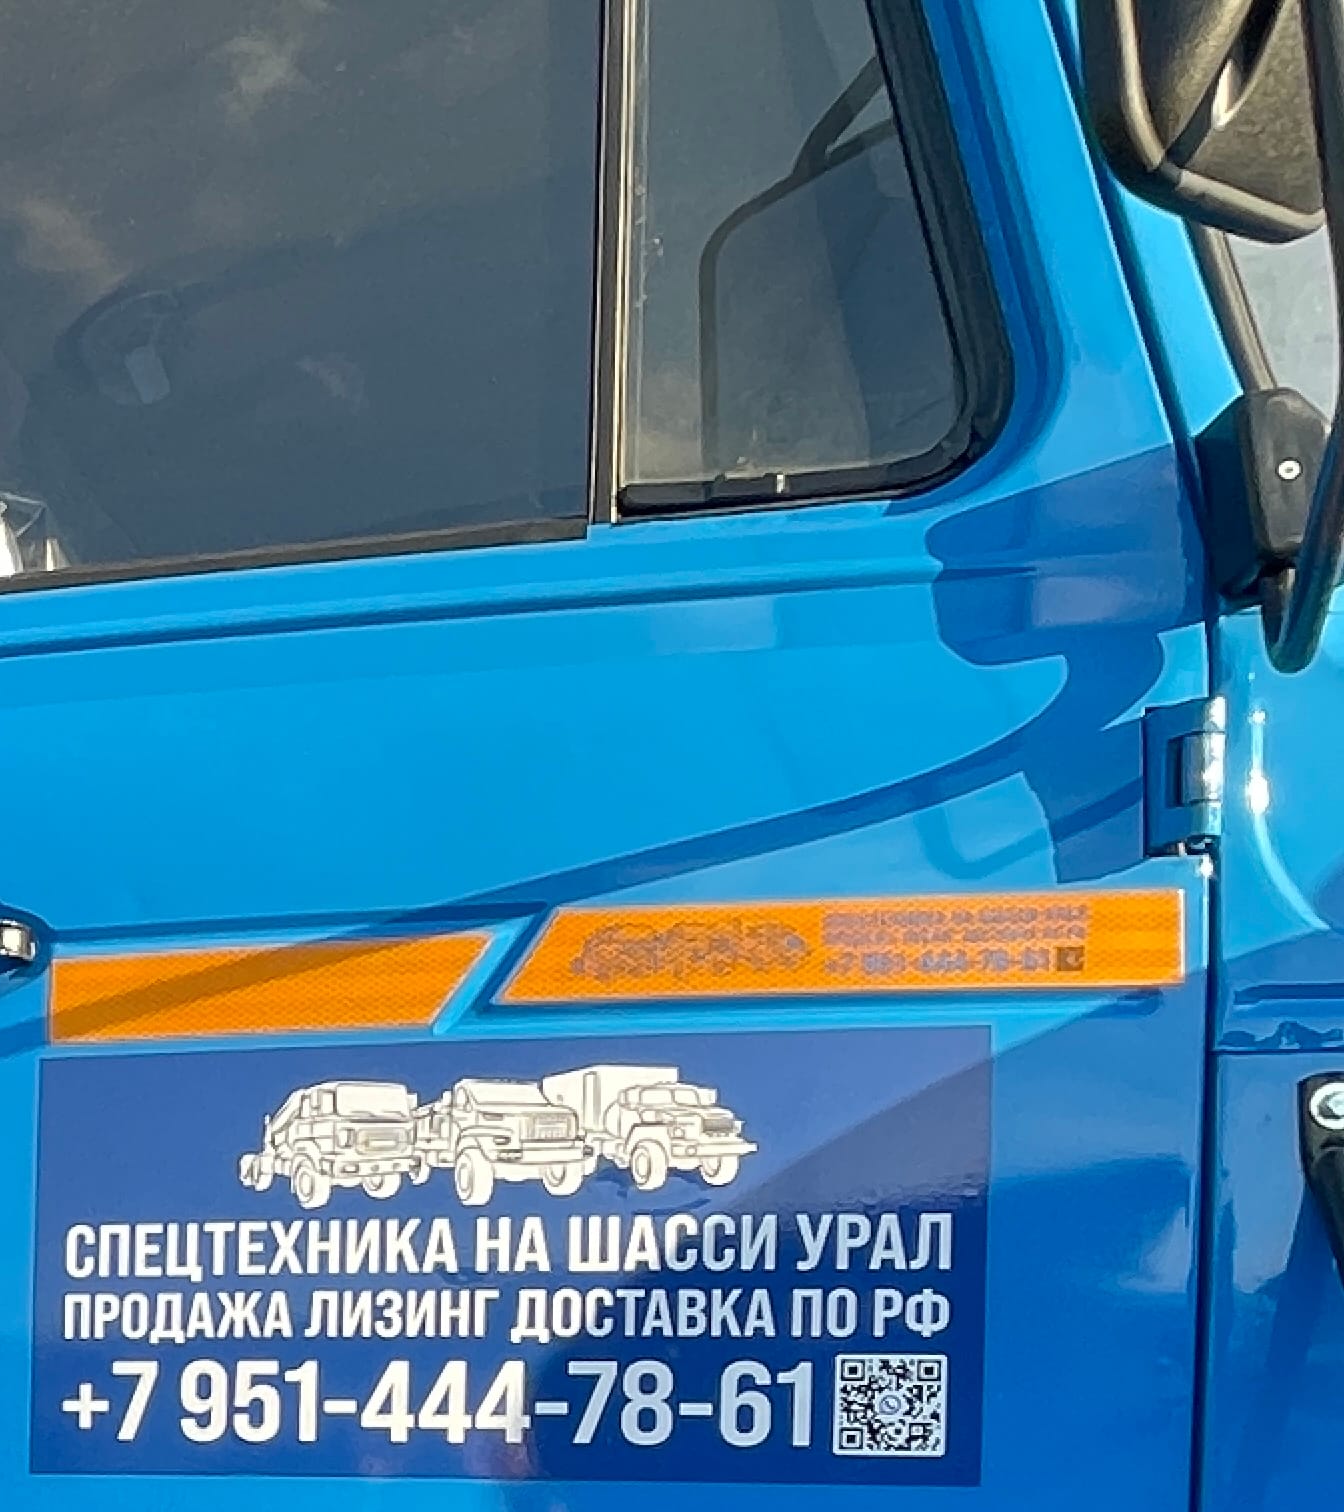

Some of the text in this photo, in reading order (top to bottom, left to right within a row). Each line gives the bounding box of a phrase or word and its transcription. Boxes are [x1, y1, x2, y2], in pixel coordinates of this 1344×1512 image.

[65, 1212, 952, 1283] СПЕЦТЕХНИКА НА ШАССИ УРАЛ
[63, 1287, 950, 1344] ПРОДАЖА ЛИЗИНГ ДОСТАВКА ПО РФ
[62, 1359, 812, 1447] +7 951-444-78-61
